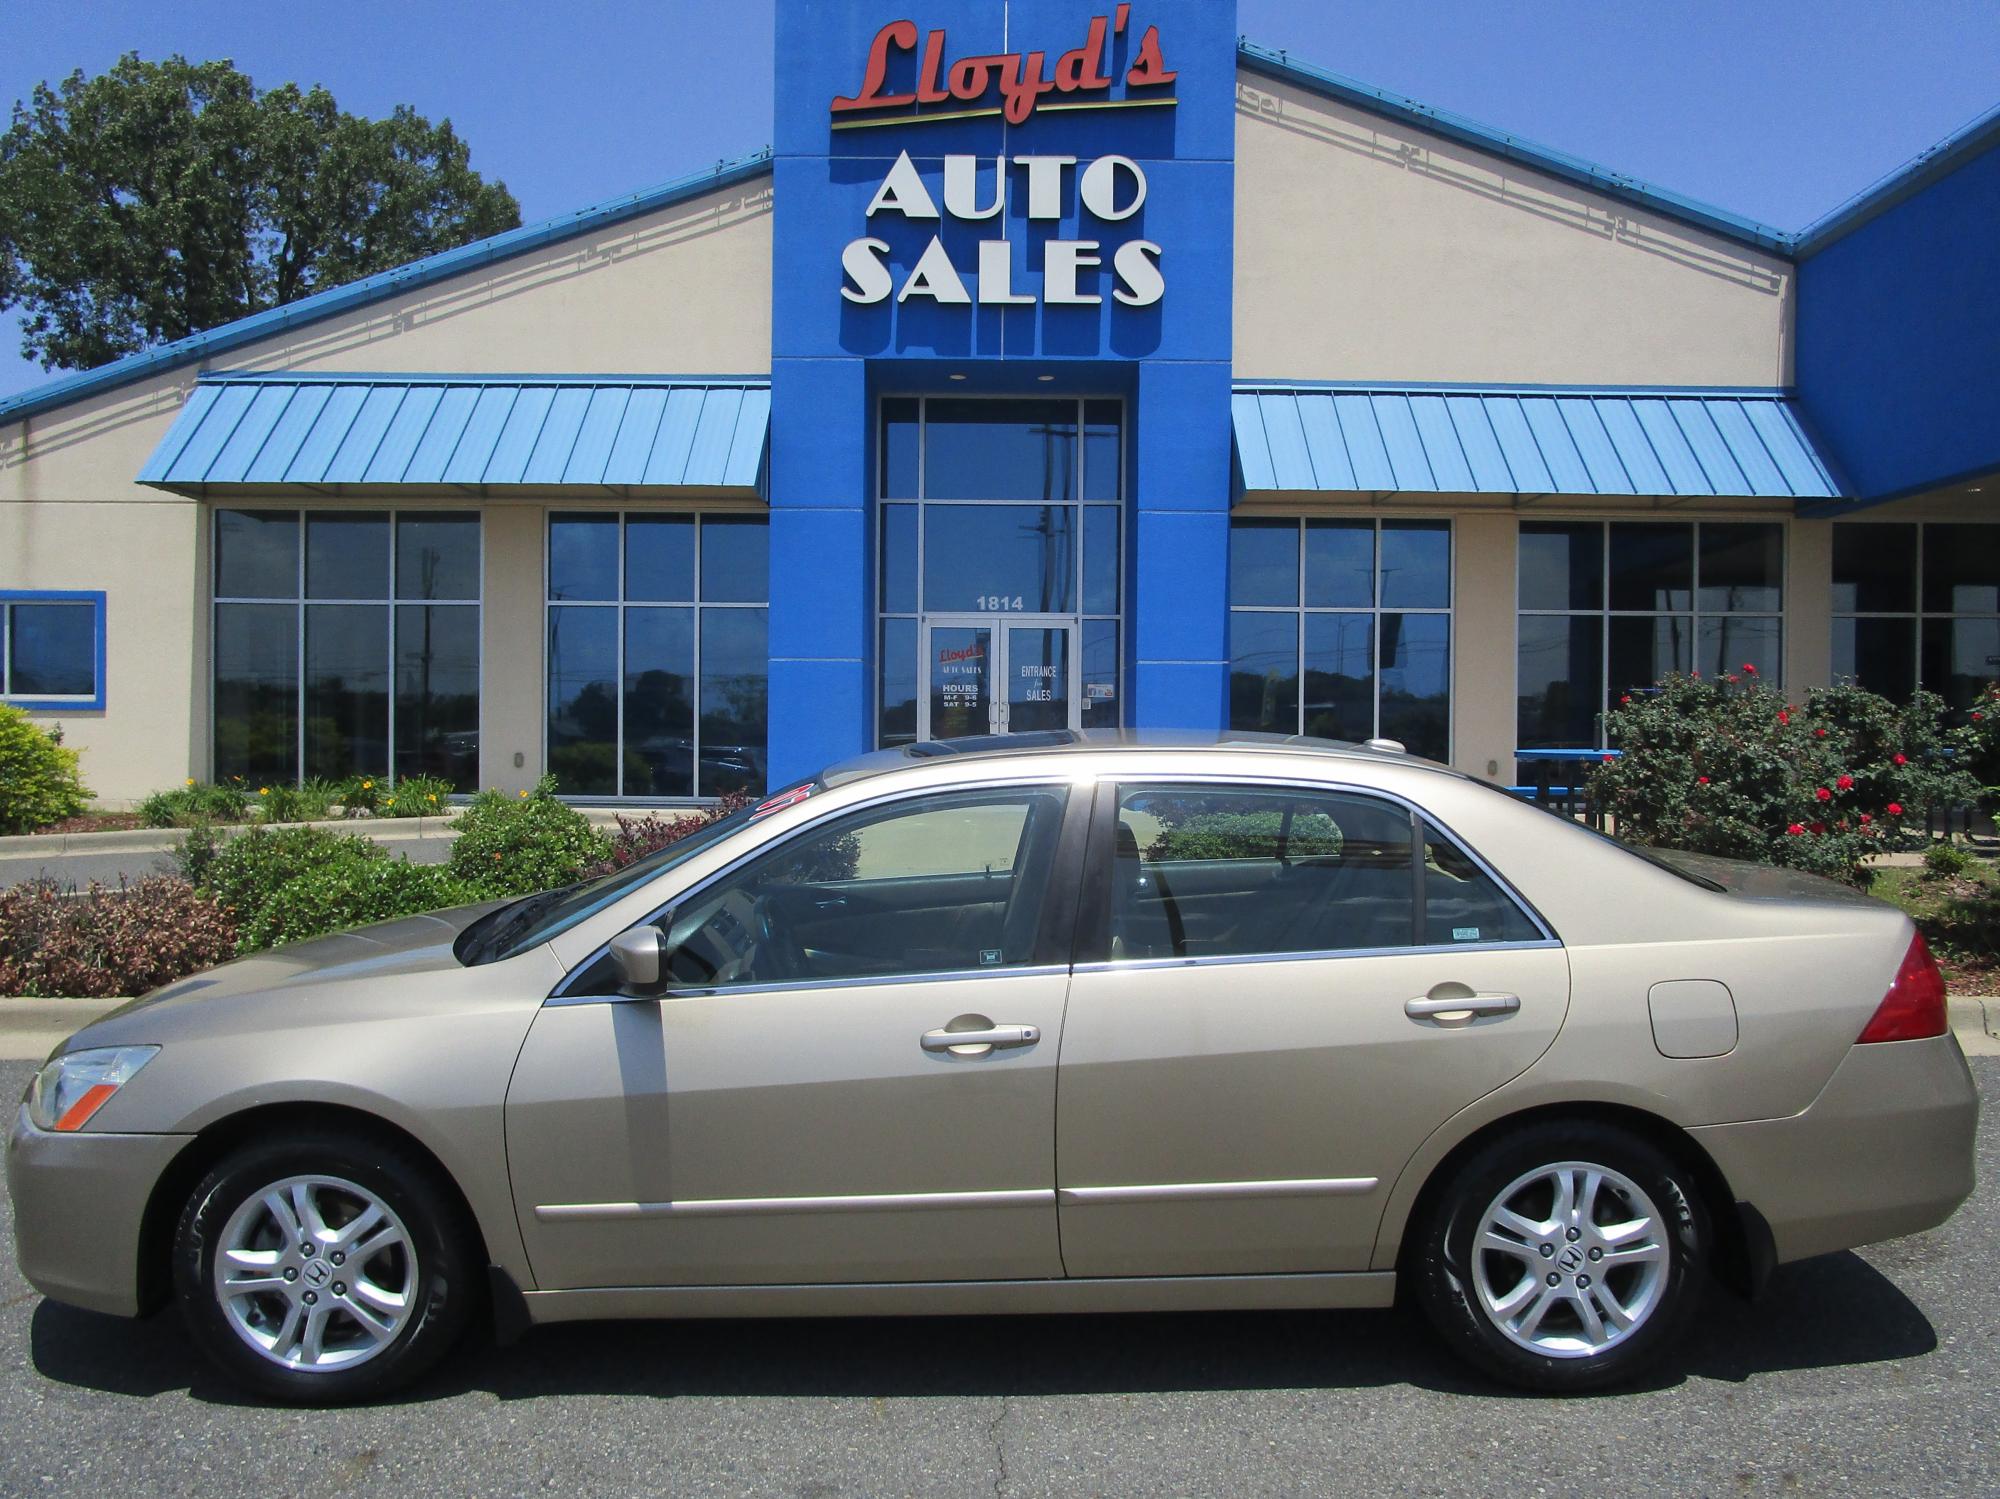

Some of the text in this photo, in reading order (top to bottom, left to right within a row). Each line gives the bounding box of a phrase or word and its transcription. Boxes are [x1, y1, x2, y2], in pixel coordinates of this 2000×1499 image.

[830, 3, 1178, 125] Lloyd's
[865, 149, 1147, 220] AUTO
[840, 234, 1165, 306] SALES
[977, 596, 1023, 611] 1814
[1021, 665, 1057, 677] ENTRANCE
[1026, 689, 1052, 701] SALES
